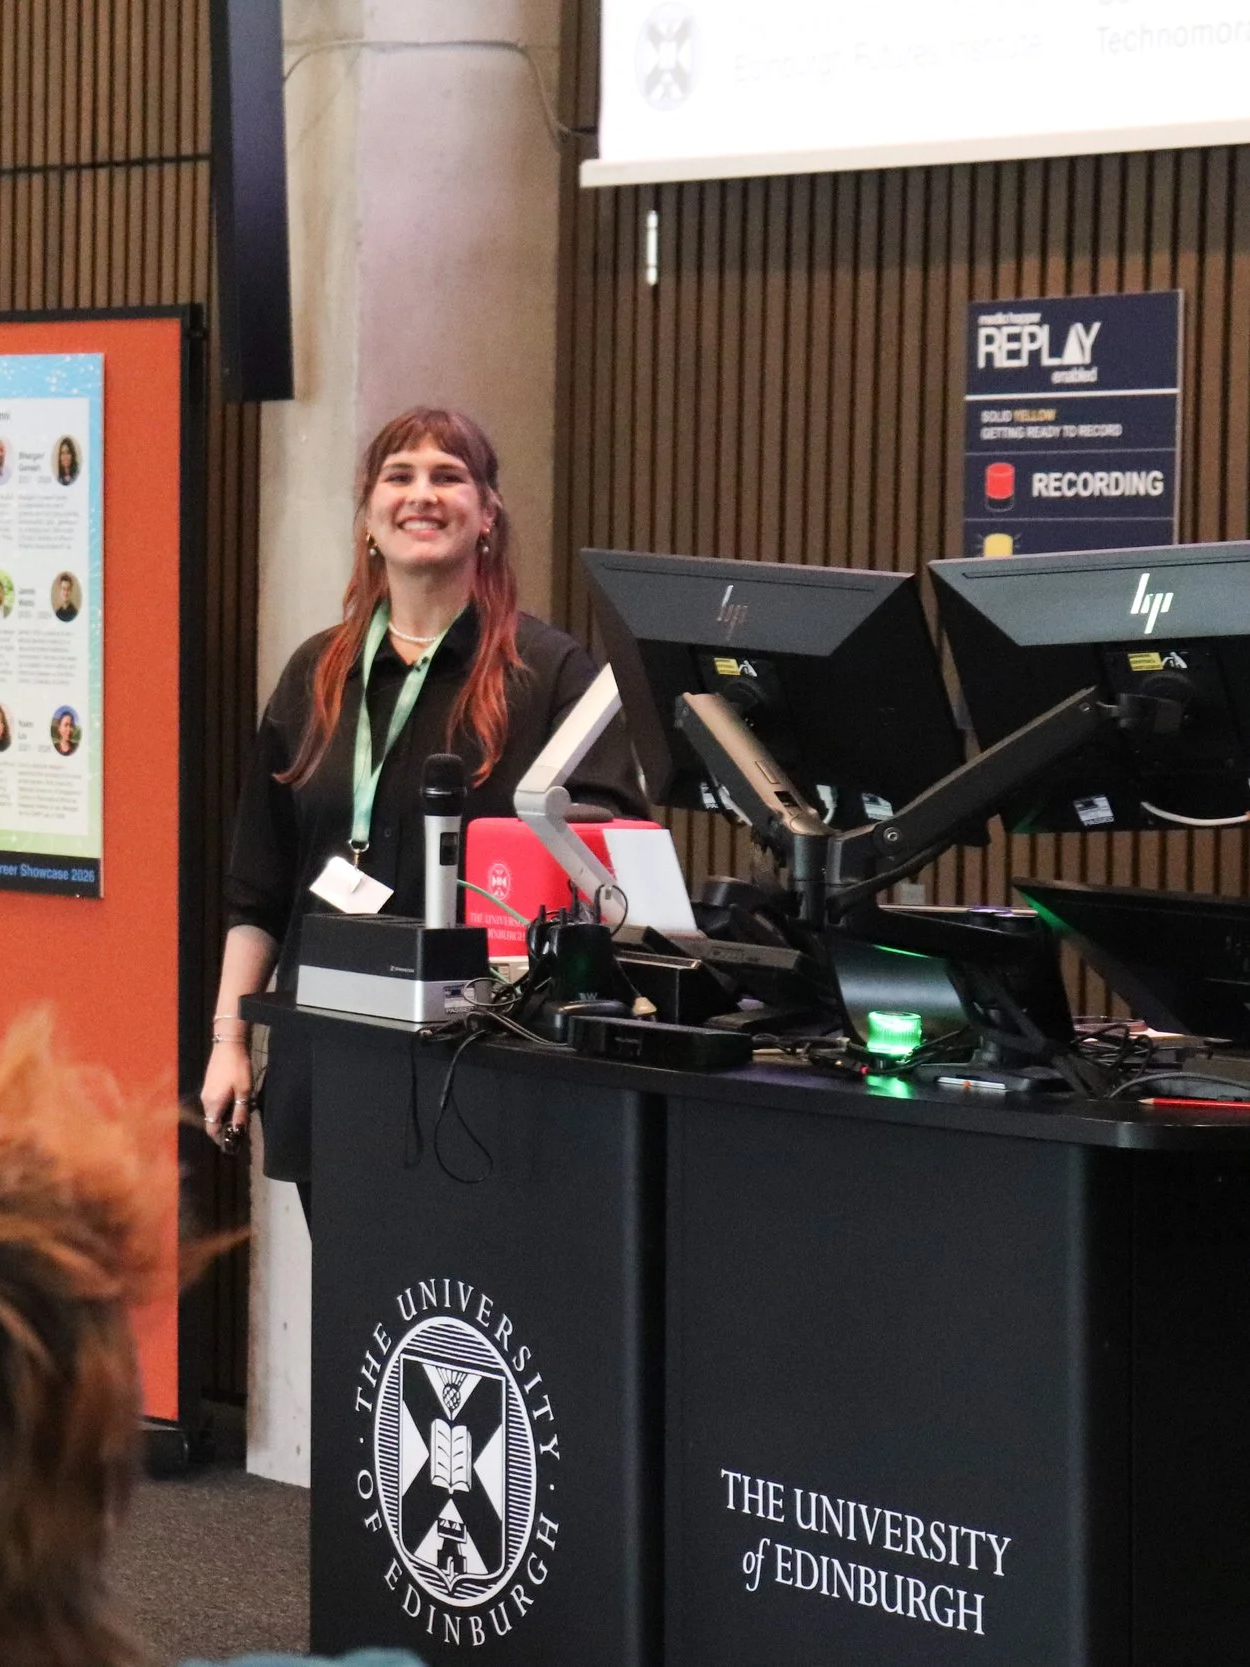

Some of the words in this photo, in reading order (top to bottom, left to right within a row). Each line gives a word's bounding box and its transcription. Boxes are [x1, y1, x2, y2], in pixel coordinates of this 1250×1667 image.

[977, 321, 1102, 369] REPLAY
[980, 410, 1012, 423] SOLID
[1013, 408, 1057, 422] YELLOW
[980, 426, 1025, 440] GETTING
[1025, 425, 1062, 439] READY
[1062, 424, 1077, 438] TO
[1077, 423, 1123, 438] RECORD
[1031, 470, 1164, 497] RECORDING
[1130, 573, 1174, 634] hp
[20, 863, 69, 881] Showcase
[70, 868, 96, 882] 2026
[355, 1323, 392, 1413] THE
[396, 1278, 561, 1461] UNIVERSITY
[720, 1468, 786, 1523] THE
[793, 1488, 1012, 1577] UNIVERSITY
[356, 1469, 384, 1534] OF
[383, 1520, 561, 1648] EDINBURGH
[742, 1537, 771, 1592] of
[774, 1543, 986, 1636] EDINBURGH
